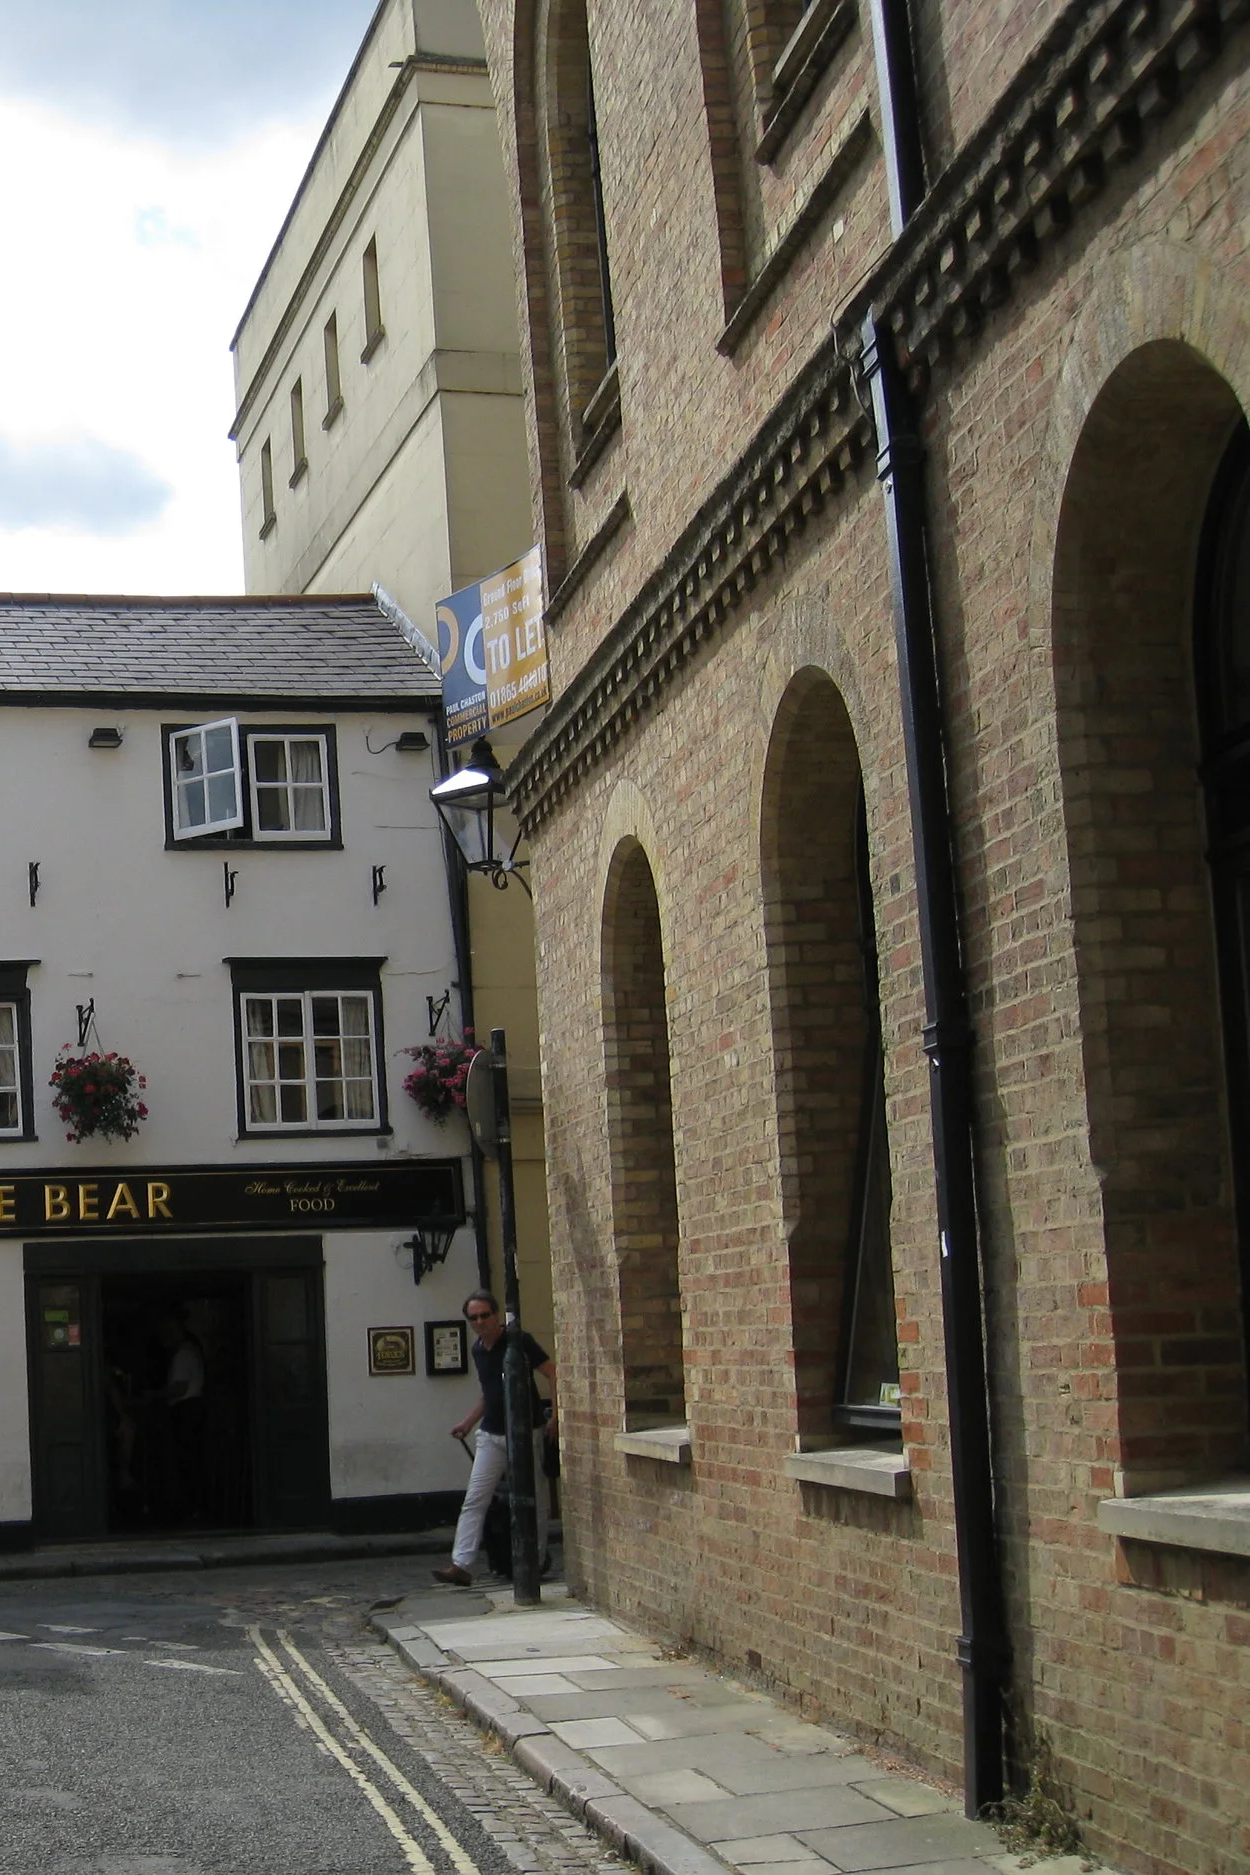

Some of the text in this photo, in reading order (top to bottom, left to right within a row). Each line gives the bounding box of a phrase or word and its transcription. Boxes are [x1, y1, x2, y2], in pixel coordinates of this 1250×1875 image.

[486, 615, 545, 674] TO LET
[490, 681, 517, 709] 01865
[446, 702, 460, 716] PAUL
[446, 702, 487, 729] COMMERCIAL
[244, 1180, 281, 1195] Home
[284, 1180, 320, 1194] Cooked
[336, 1178, 380, 1193] Excellent
[44, 1182, 173, 1221] BEAR
[290, 1198, 335, 1212] FOOD
